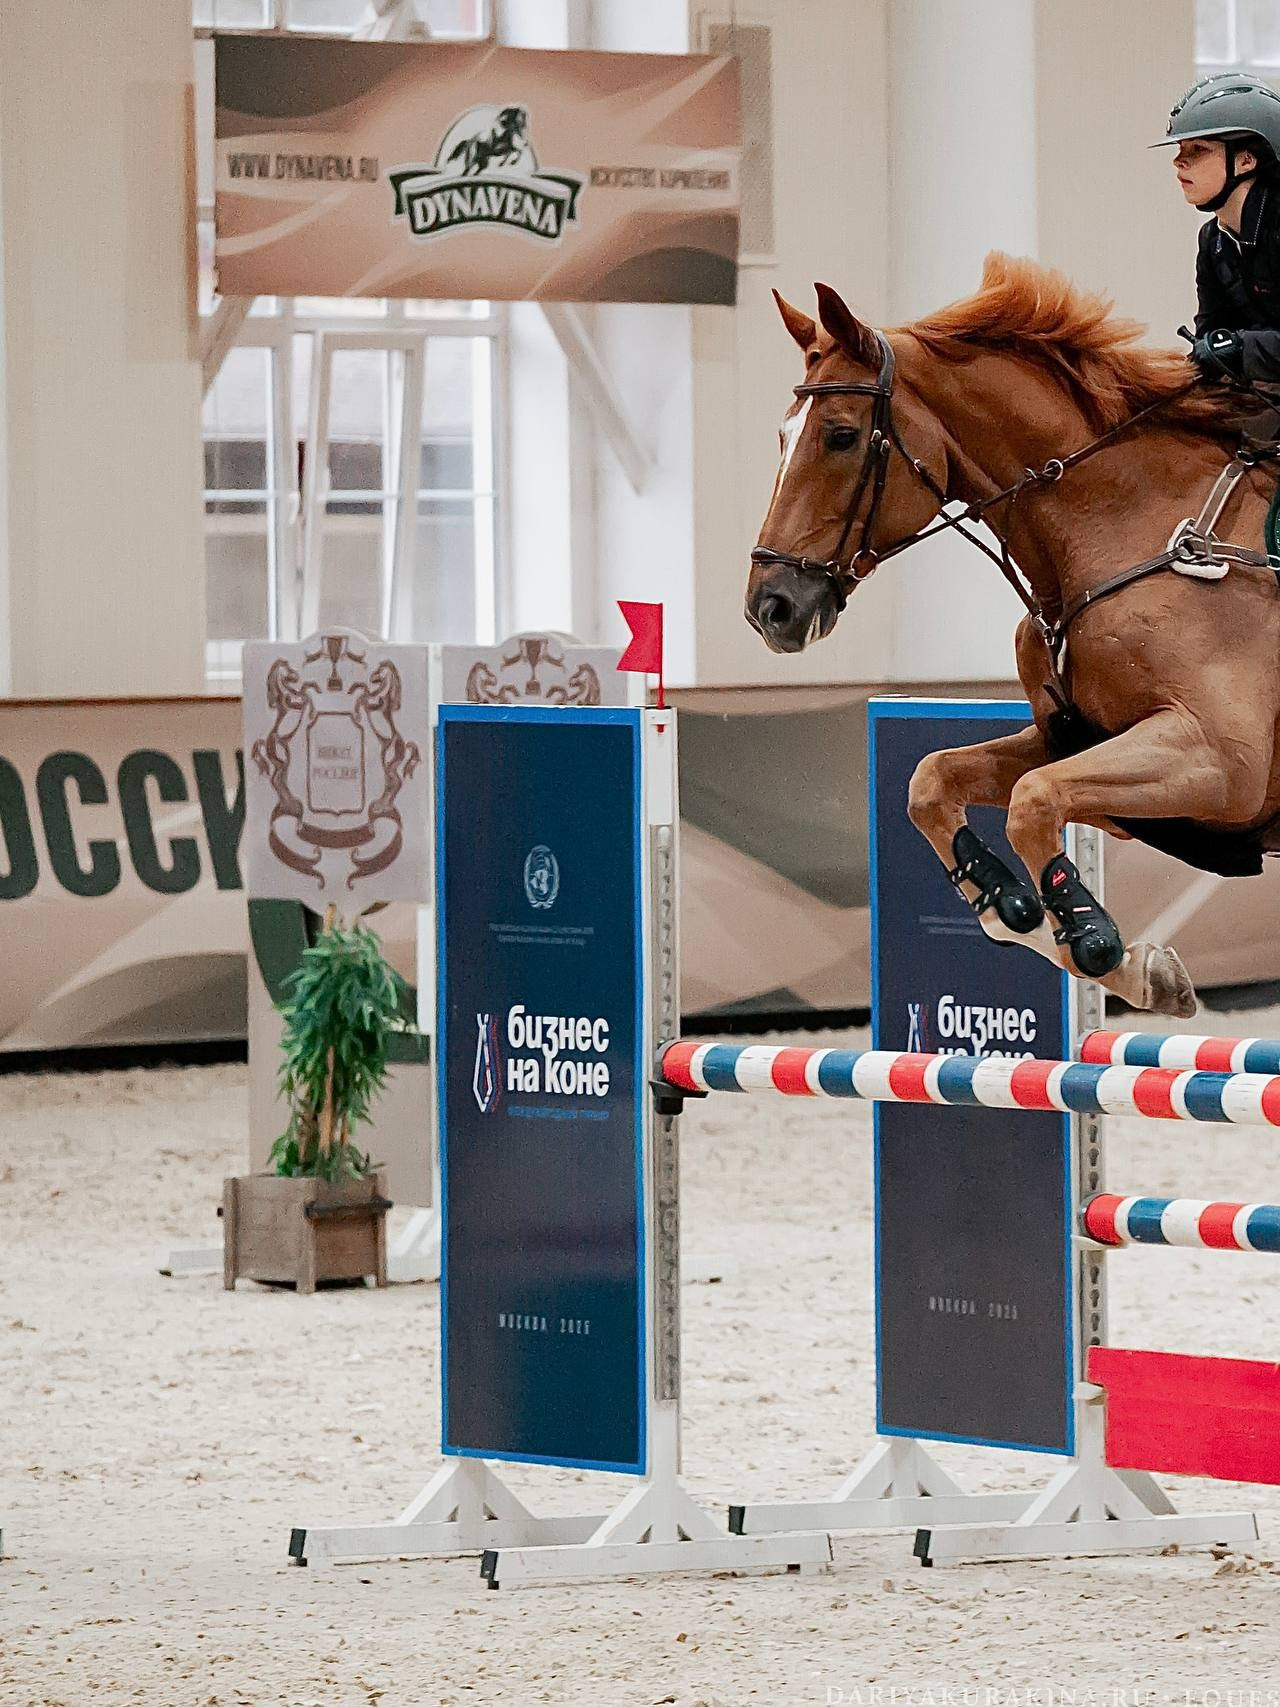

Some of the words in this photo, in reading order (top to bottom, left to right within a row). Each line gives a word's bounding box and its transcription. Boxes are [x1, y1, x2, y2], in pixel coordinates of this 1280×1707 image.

[412, 186, 557, 234] DYNAVENA
[507, 1004, 610, 1057] бизнес
[937, 995, 1037, 1047] бизнес
[507, 1058, 540, 1093] на
[544, 1057, 610, 1097] коне
